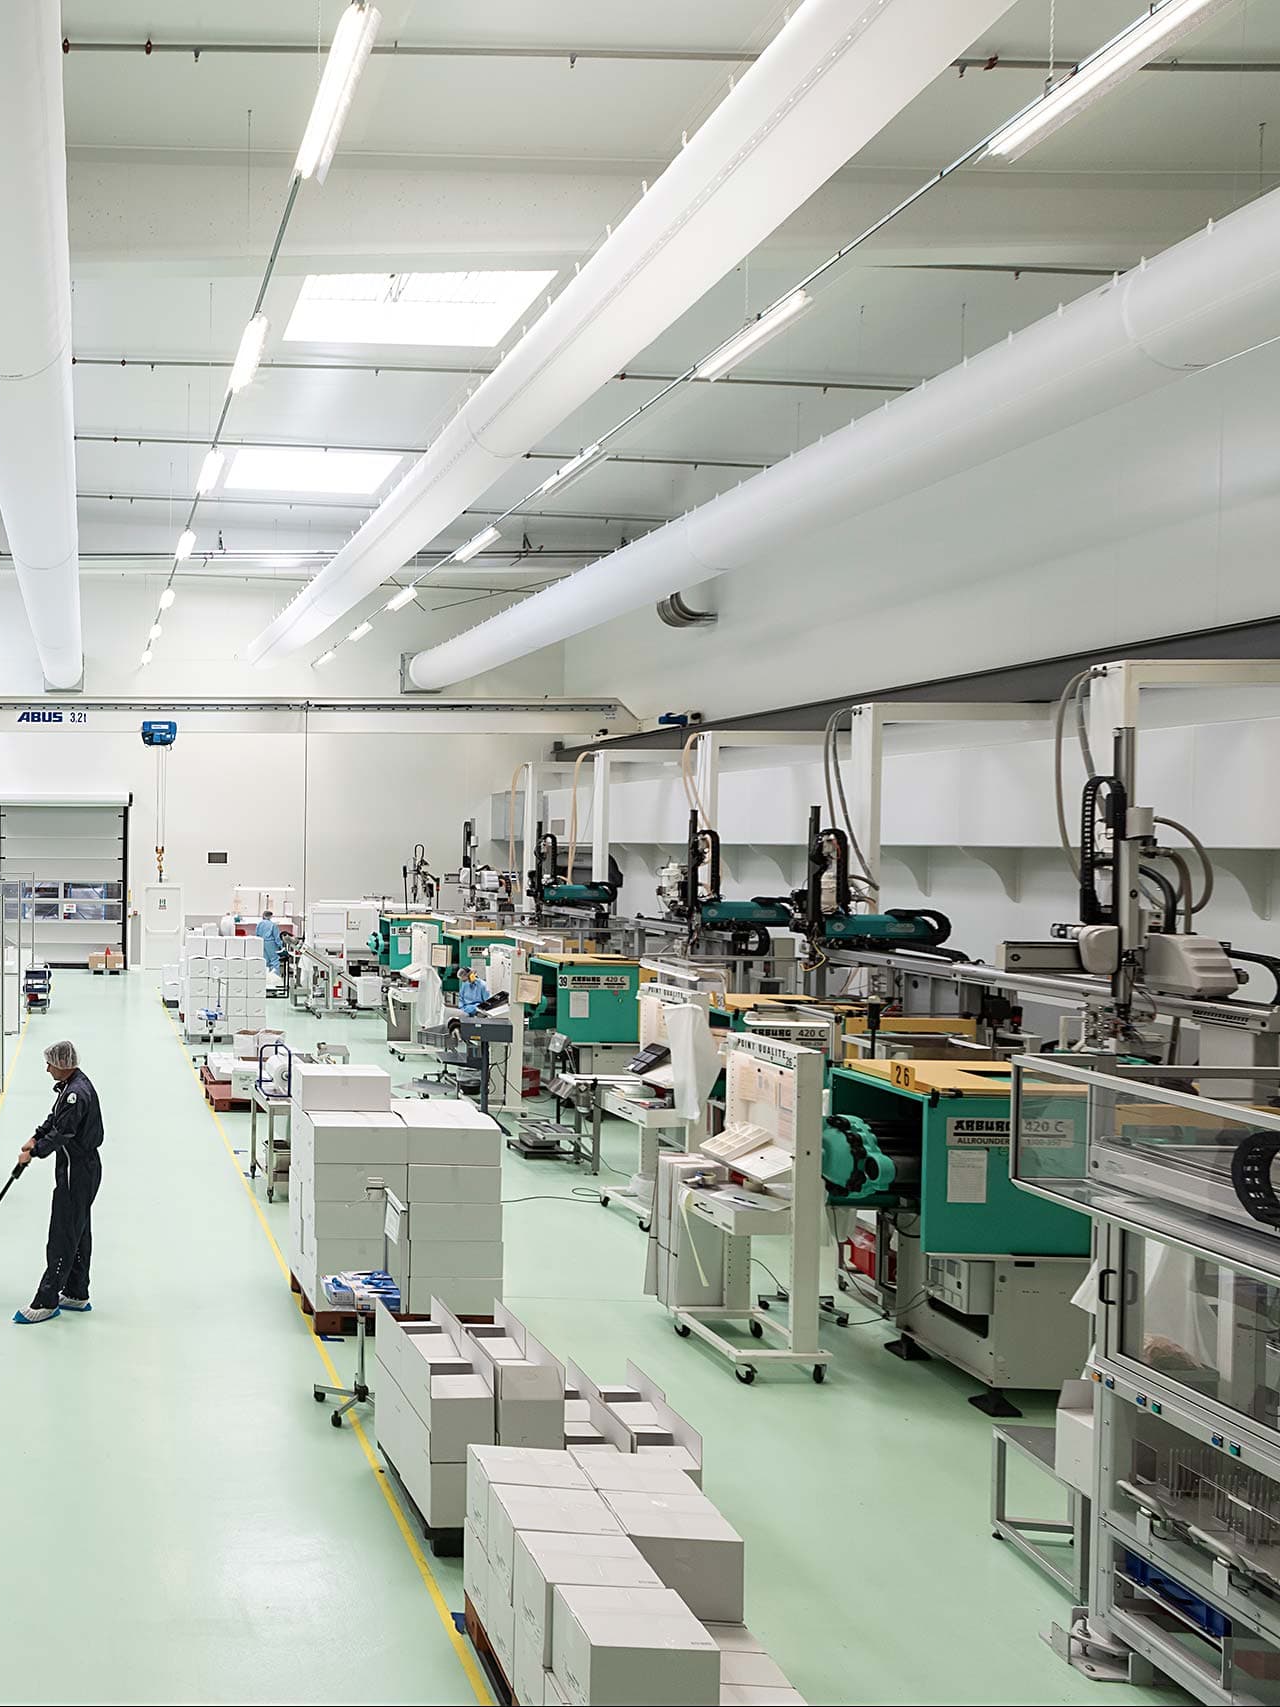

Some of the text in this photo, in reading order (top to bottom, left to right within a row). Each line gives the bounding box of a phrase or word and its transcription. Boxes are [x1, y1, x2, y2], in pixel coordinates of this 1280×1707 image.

[17, 711, 63, 723] ABUS
[559, 976, 568, 987] 39
[647, 986, 684, 999] POINT QUALITE
[798, 1029, 826, 1038] 420 C
[737, 1038, 787, 1059] POINT QUALITE
[894, 1065, 911, 1087] 26
[1024, 1120, 1065, 1132] 420 C
[956, 1137, 1010, 1145] ALLROUNDER
